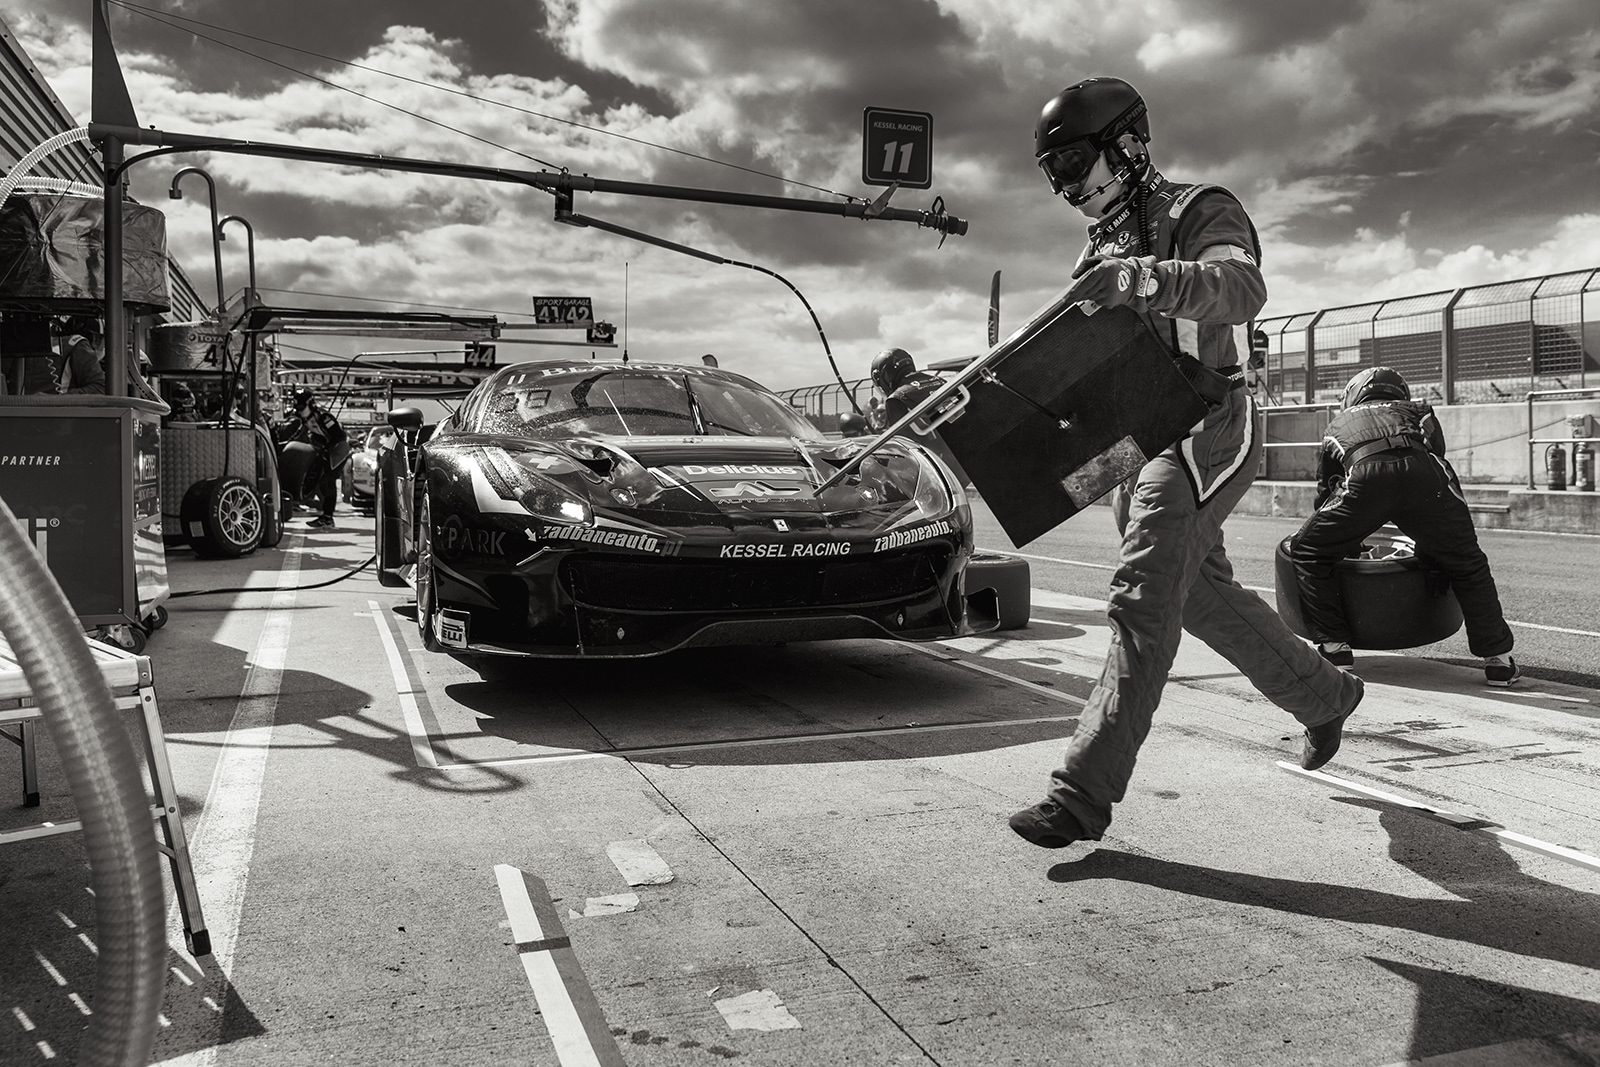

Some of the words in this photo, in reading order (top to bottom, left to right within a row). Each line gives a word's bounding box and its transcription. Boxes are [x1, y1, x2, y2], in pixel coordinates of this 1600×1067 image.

[873, 121, 897, 130] KESSEL
[897, 124, 924, 132] RACING
[882, 140, 914, 174] 11
[1105, 224, 1115, 233] LE
[1112, 208, 1130, 228] MANS
[198, 334, 227, 343] TOTA
[466, 347, 494, 367] 44
[1, 455, 61, 466] PARTNER
[683, 464, 798, 475] Delicius
[448, 526, 507, 556] PARK
[539, 525, 684, 558] zadbaneauto.pl
[720, 544, 788, 558] KESSEL
[790, 541, 852, 557] RACING
